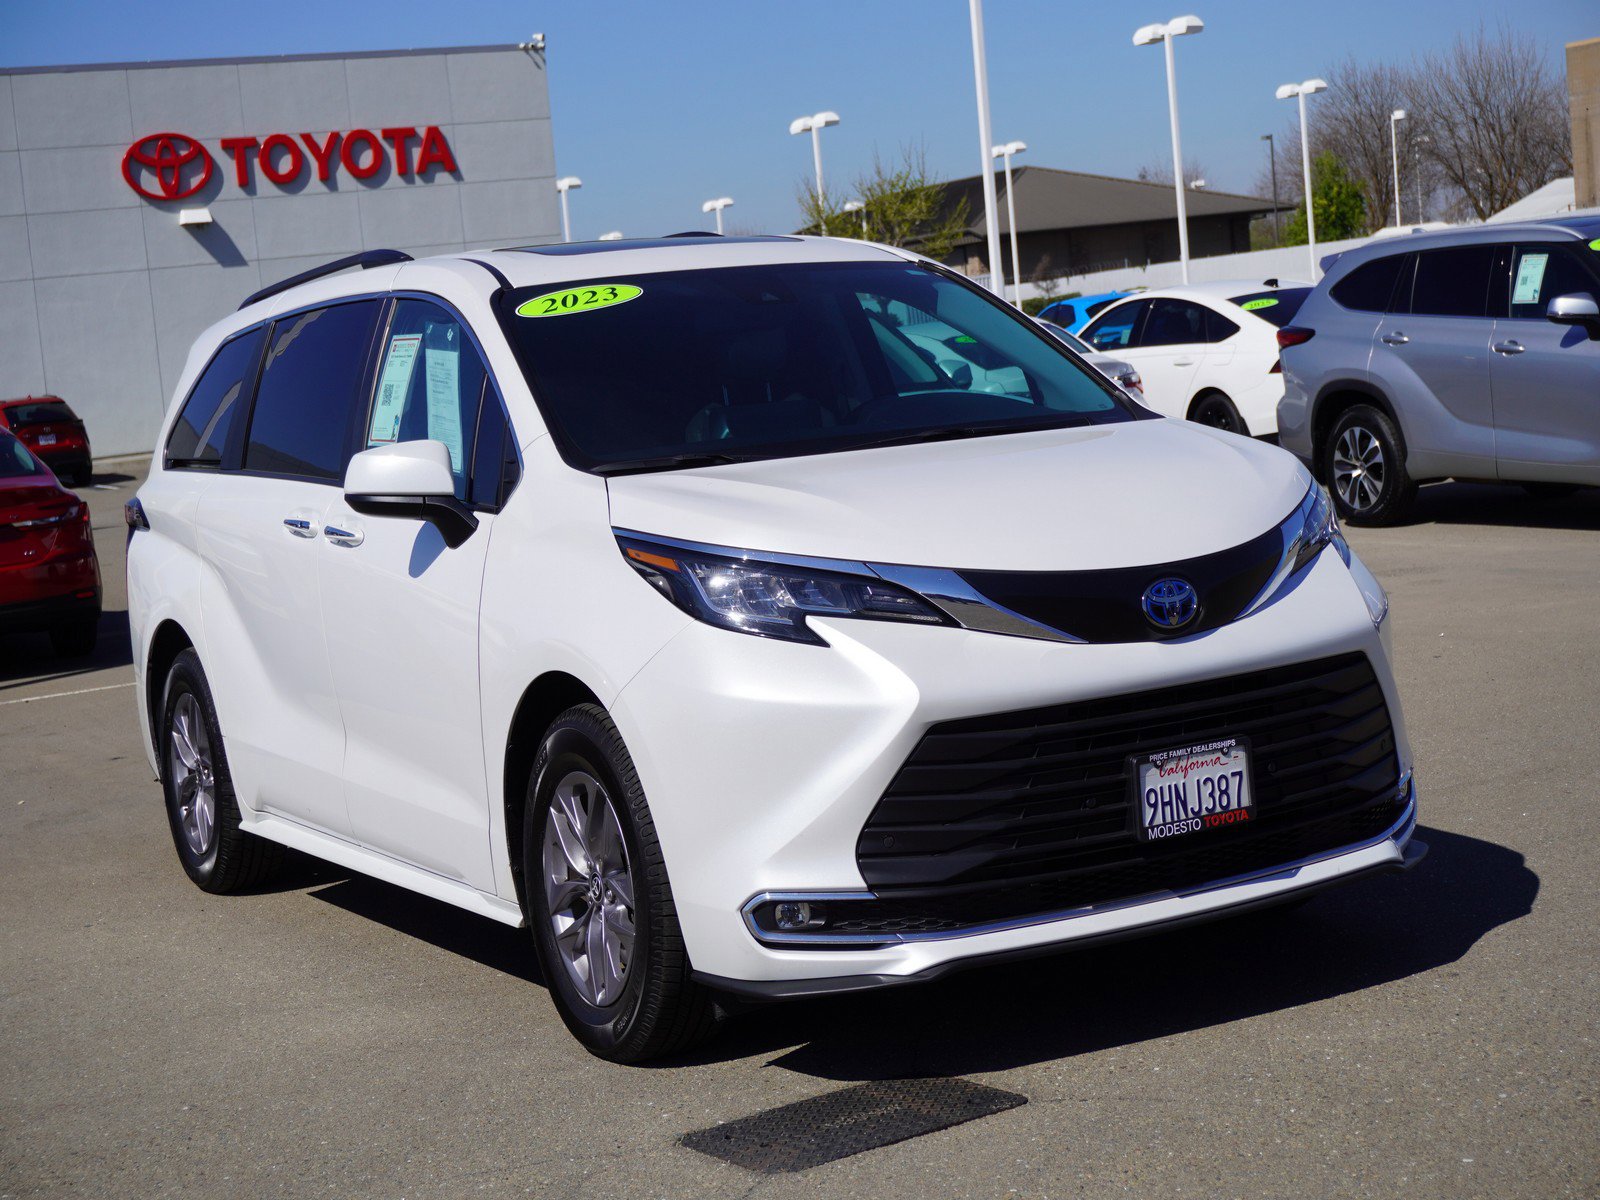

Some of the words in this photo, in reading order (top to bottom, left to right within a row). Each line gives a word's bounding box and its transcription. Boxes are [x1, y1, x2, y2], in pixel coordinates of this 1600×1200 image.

[221, 126, 457, 188] TOYOTA
[541, 287, 619, 314] 2023
[1149, 751, 1168, 763] PRICE
[1169, 747, 1192, 758] FAMILY
[1192, 739, 1236, 754] DEALERSHIPS
[1159, 755, 1229, 779] California
[1145, 770, 1243, 826] 9HNJ387
[1148, 818, 1202, 840] MODESTO
[1203, 809, 1249, 828] TOYOTA
